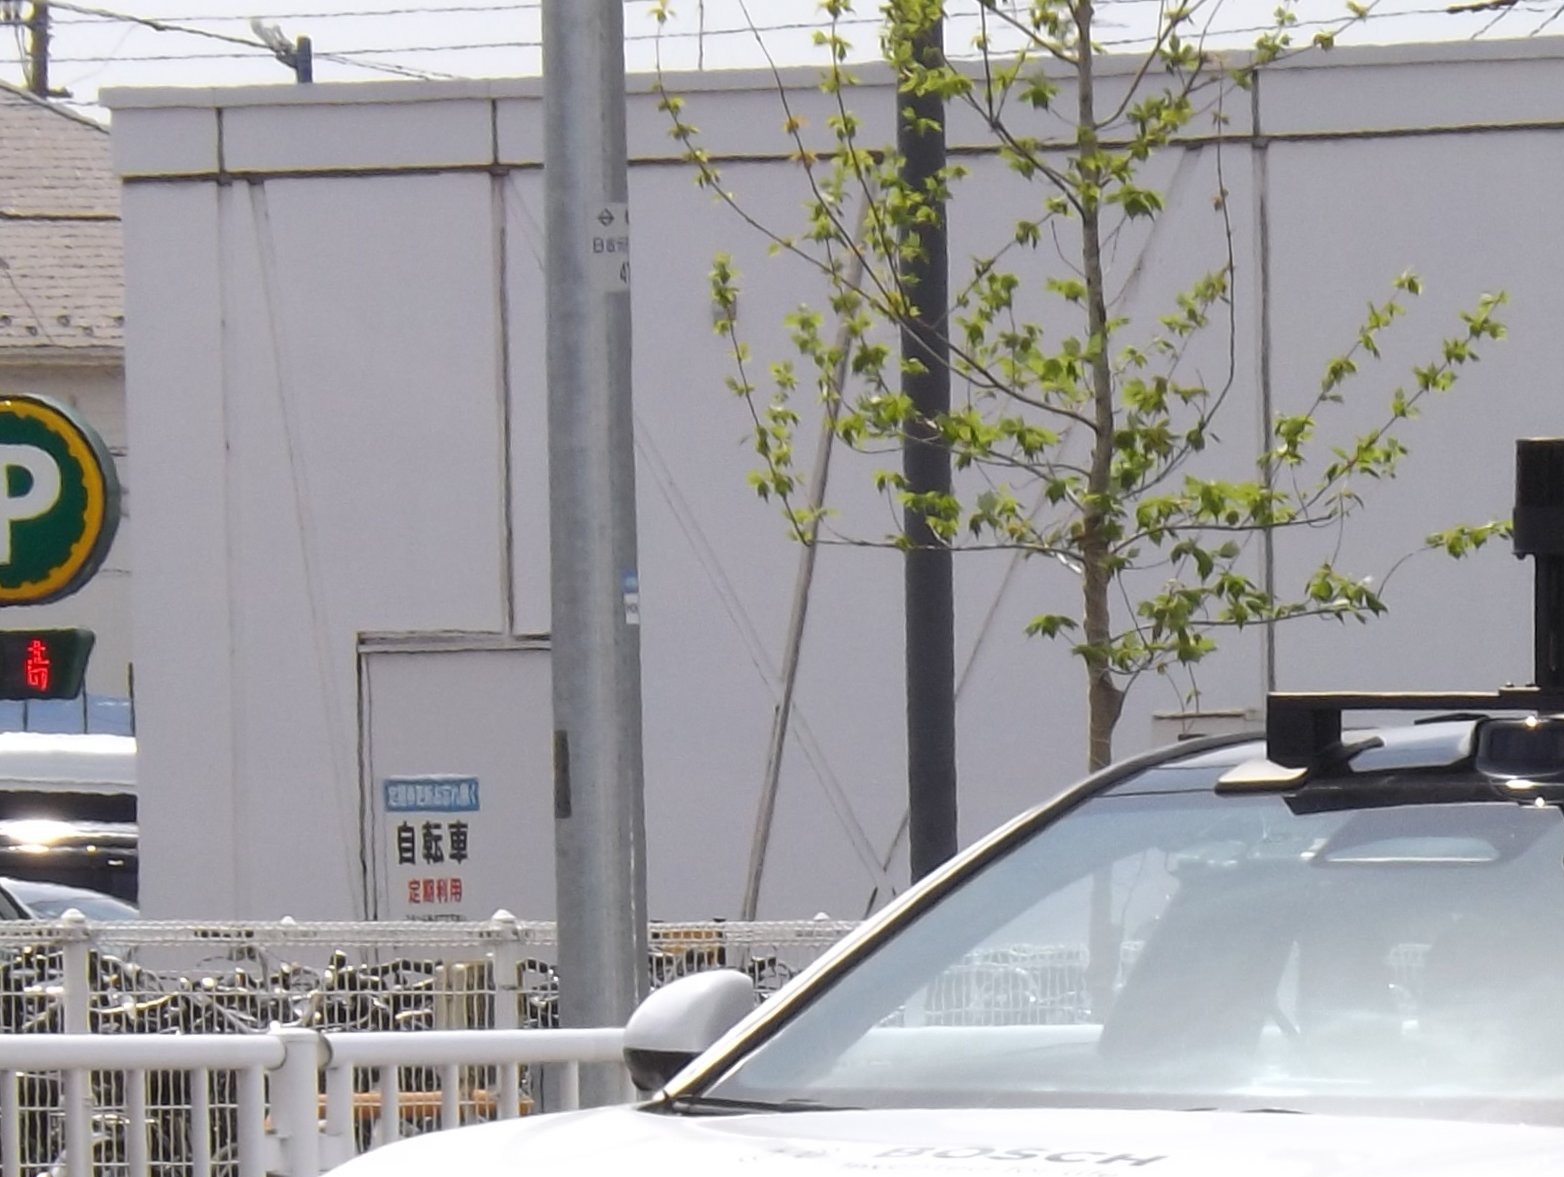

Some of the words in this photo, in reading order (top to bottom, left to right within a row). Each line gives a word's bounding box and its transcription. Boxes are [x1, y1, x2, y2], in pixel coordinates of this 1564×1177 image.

[0, 443, 61, 566] P
[397, 820, 469, 865] 自転車
[873, 1145, 1169, 1168] BOSCH
